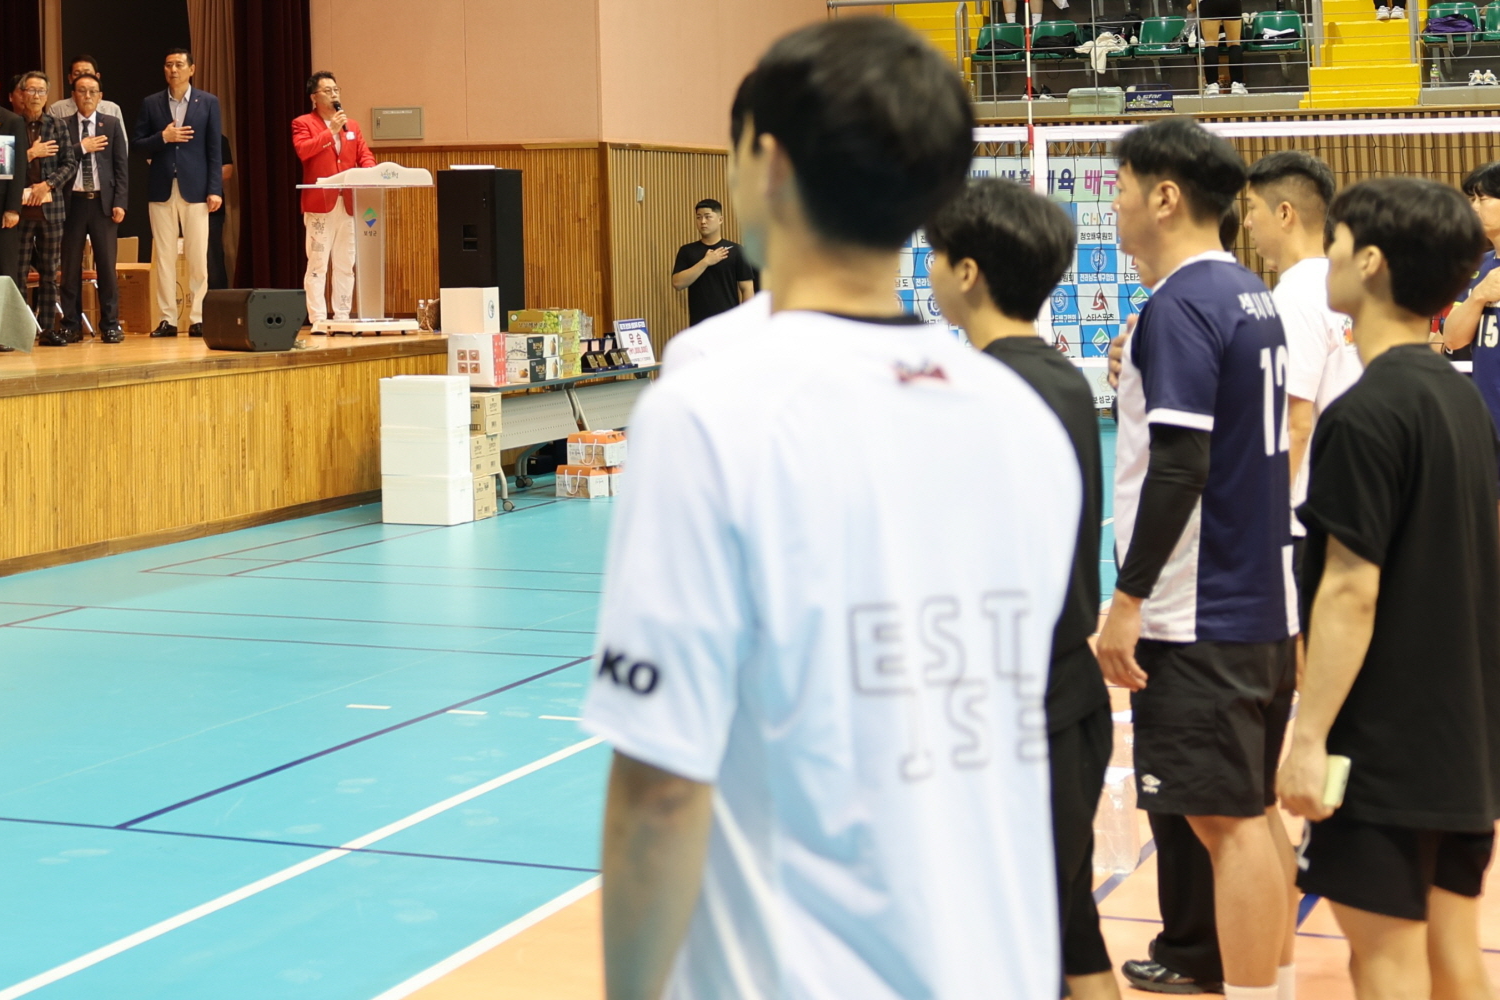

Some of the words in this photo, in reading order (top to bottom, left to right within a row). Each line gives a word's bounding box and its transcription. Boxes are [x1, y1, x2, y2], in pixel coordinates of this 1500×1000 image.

[1080, 232, 1113, 241] 청호배후원회
[1085, 313, 1115, 322] 스타스포츠
[1476, 314, 1500, 349] 15
